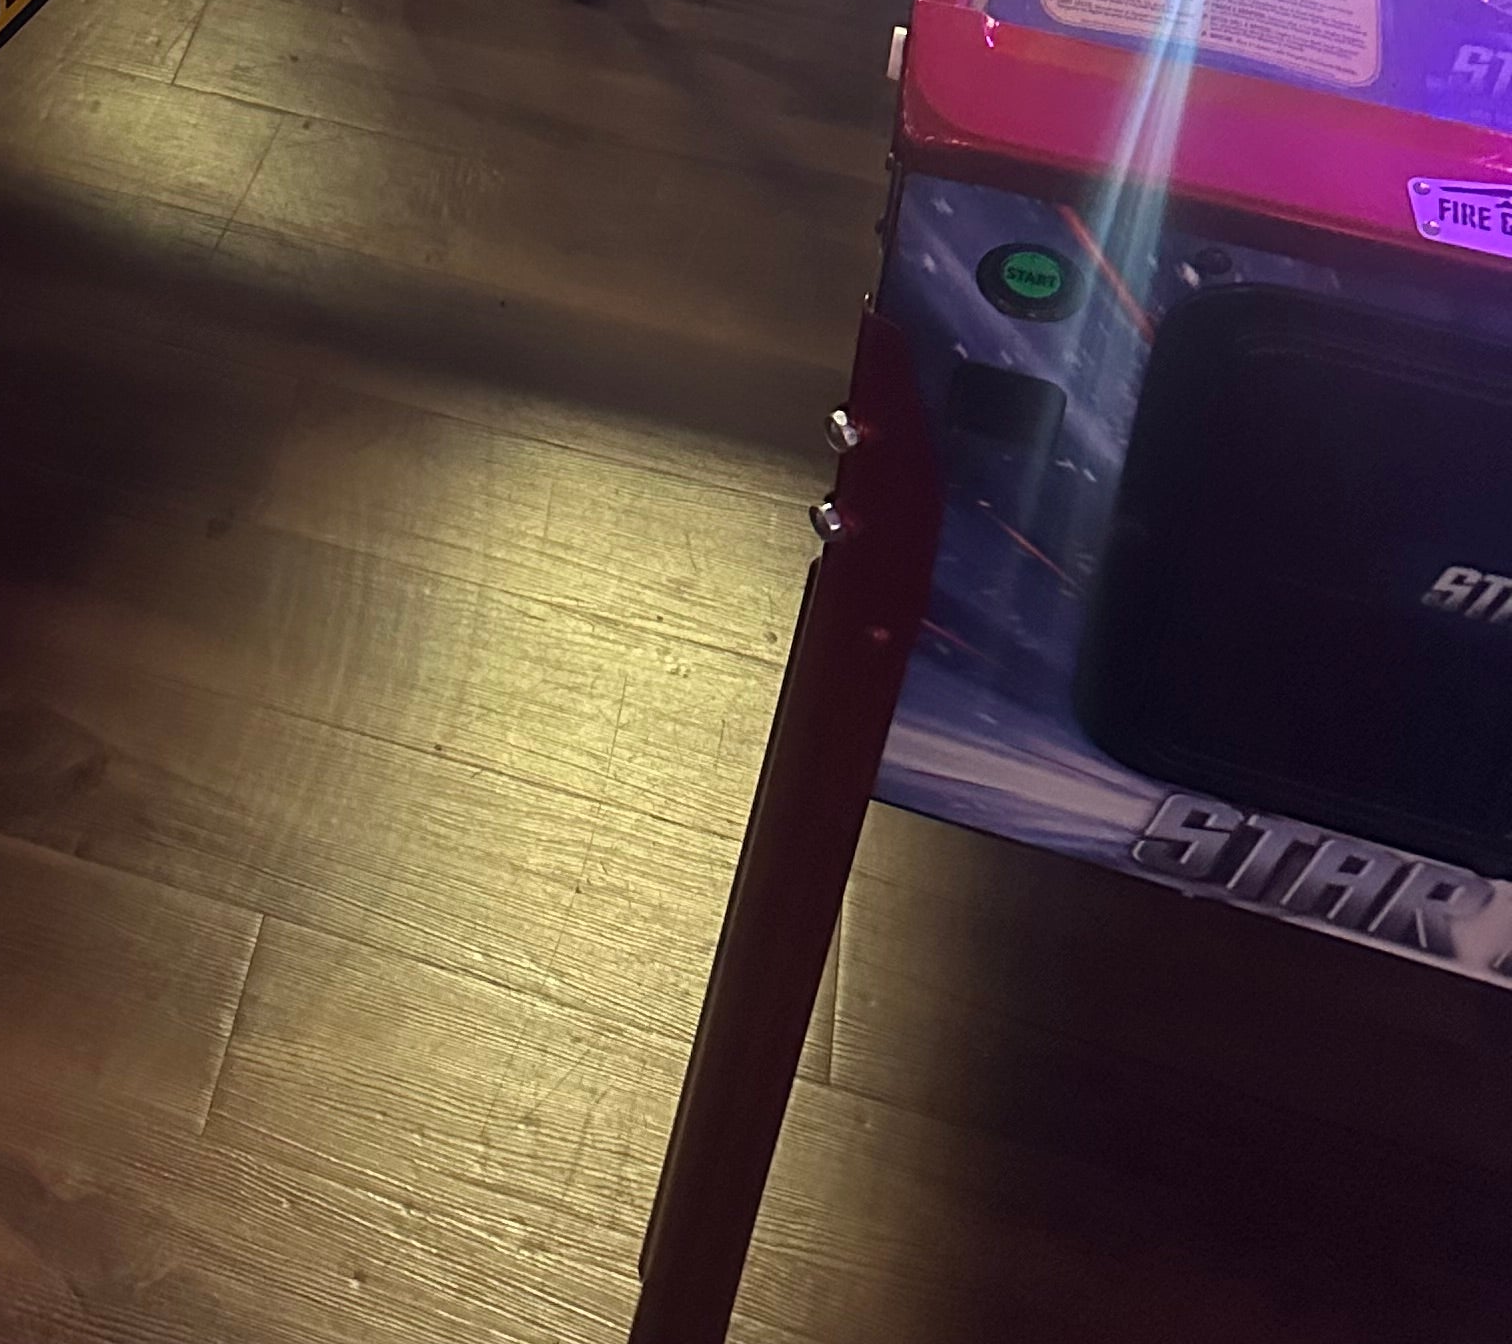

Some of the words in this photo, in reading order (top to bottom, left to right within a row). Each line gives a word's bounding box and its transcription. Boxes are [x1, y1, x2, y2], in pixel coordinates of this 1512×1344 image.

[1438, 197, 1492, 233] FIRE
[1006, 265, 1059, 289] START
[1131, 792, 1496, 962] STAR
